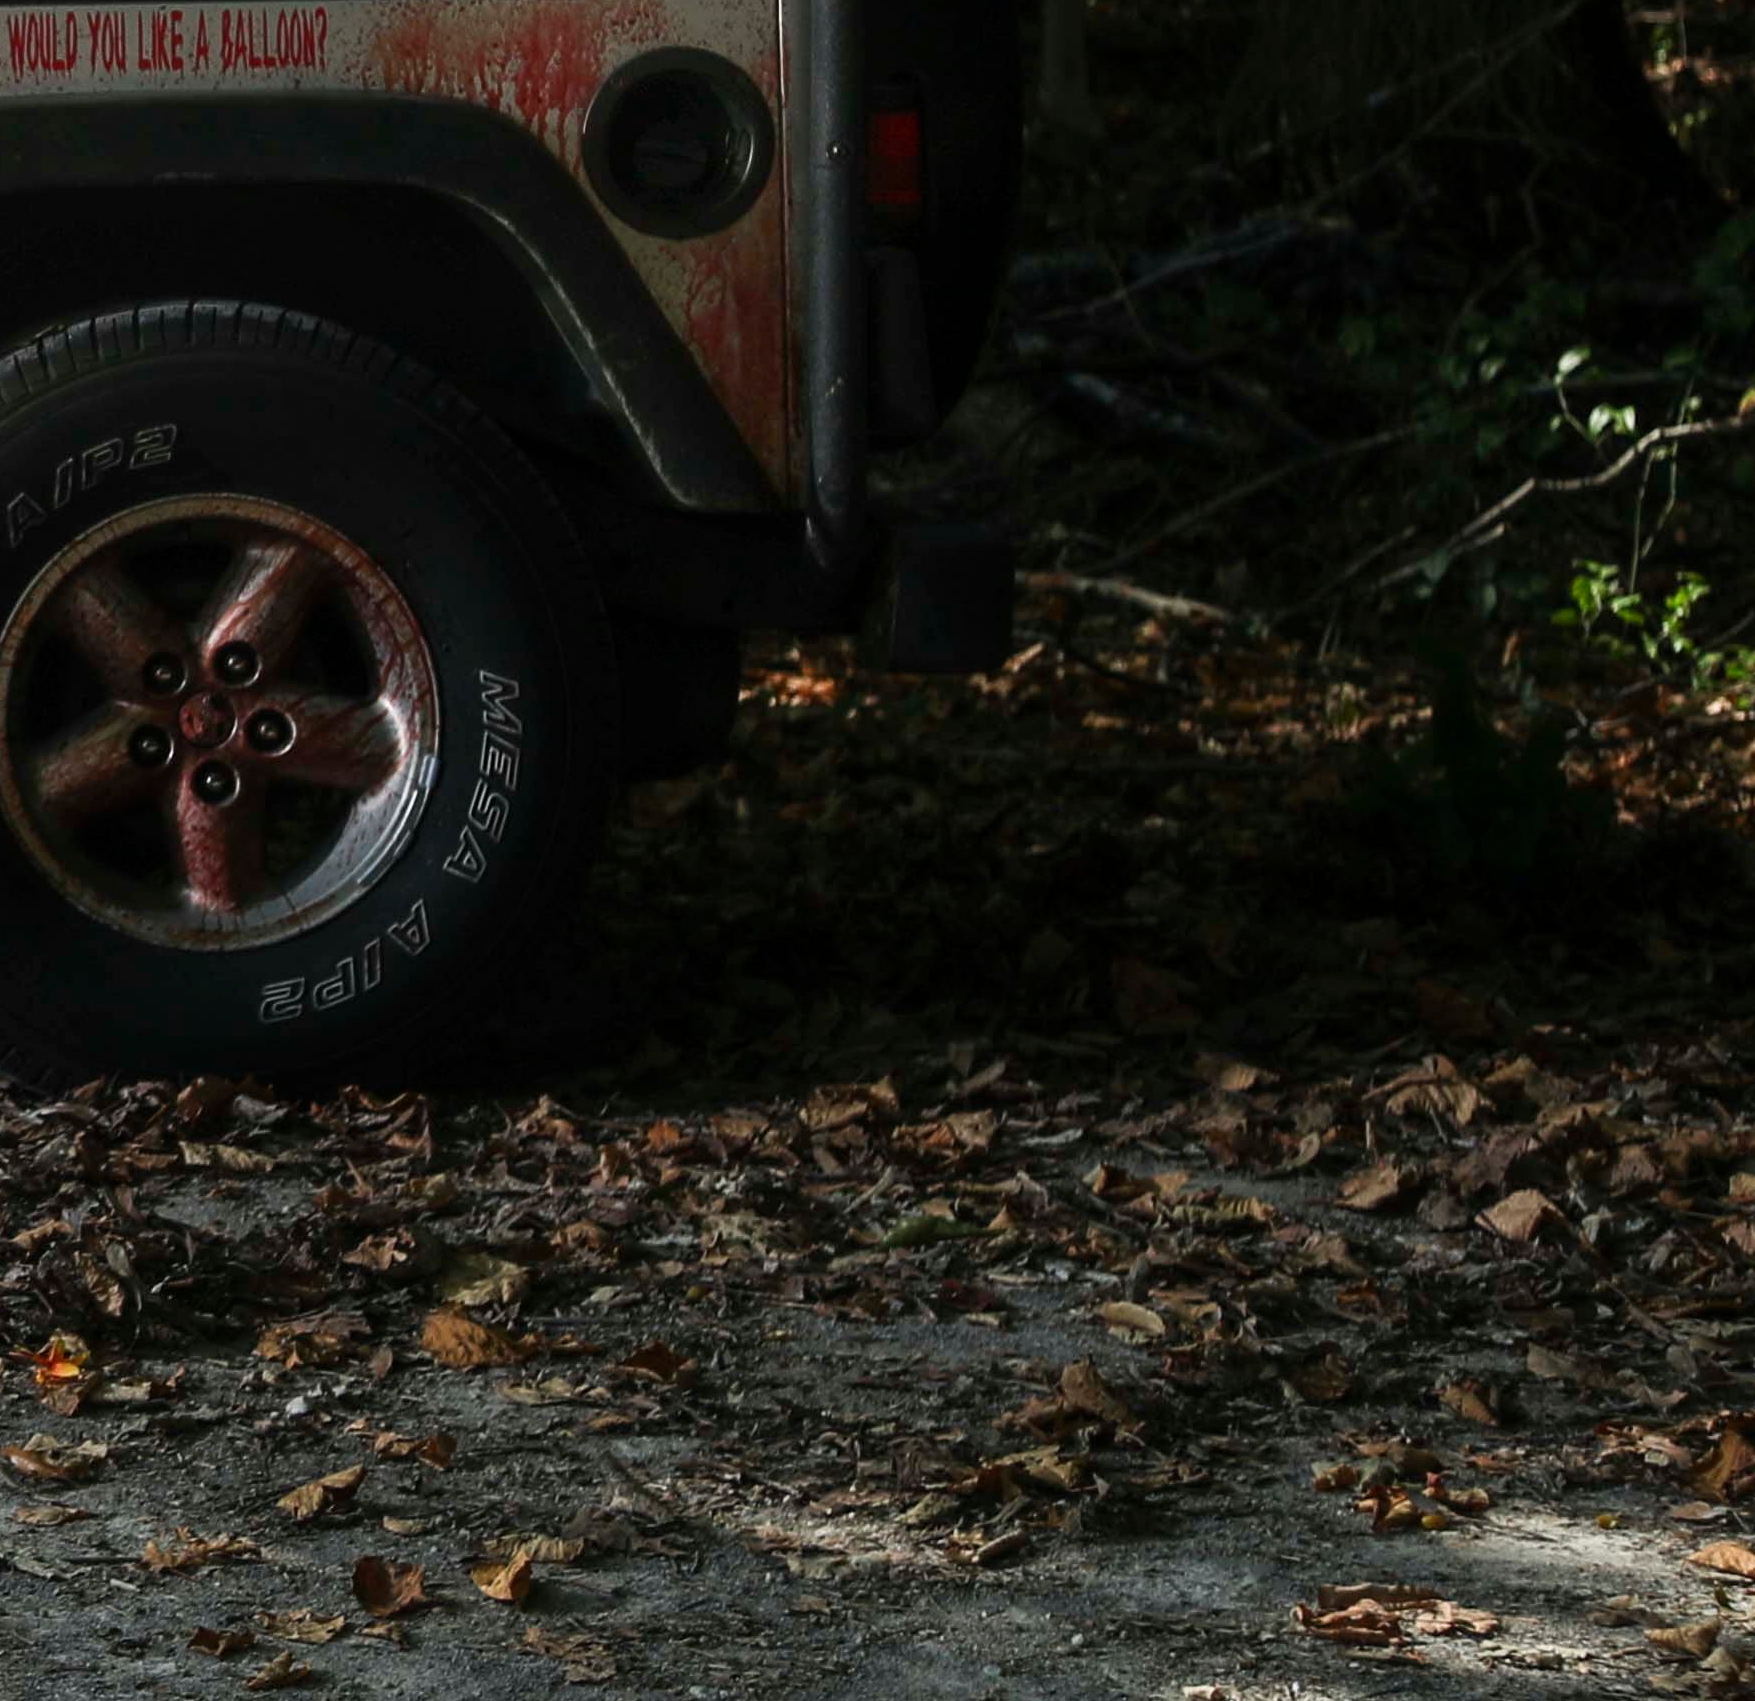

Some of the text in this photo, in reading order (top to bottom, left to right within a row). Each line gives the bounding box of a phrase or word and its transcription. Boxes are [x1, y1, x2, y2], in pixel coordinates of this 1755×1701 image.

[7, 6, 328, 80] WOULD YOU LIKE A BALLOON?
[443, 668, 524, 885] MESA
